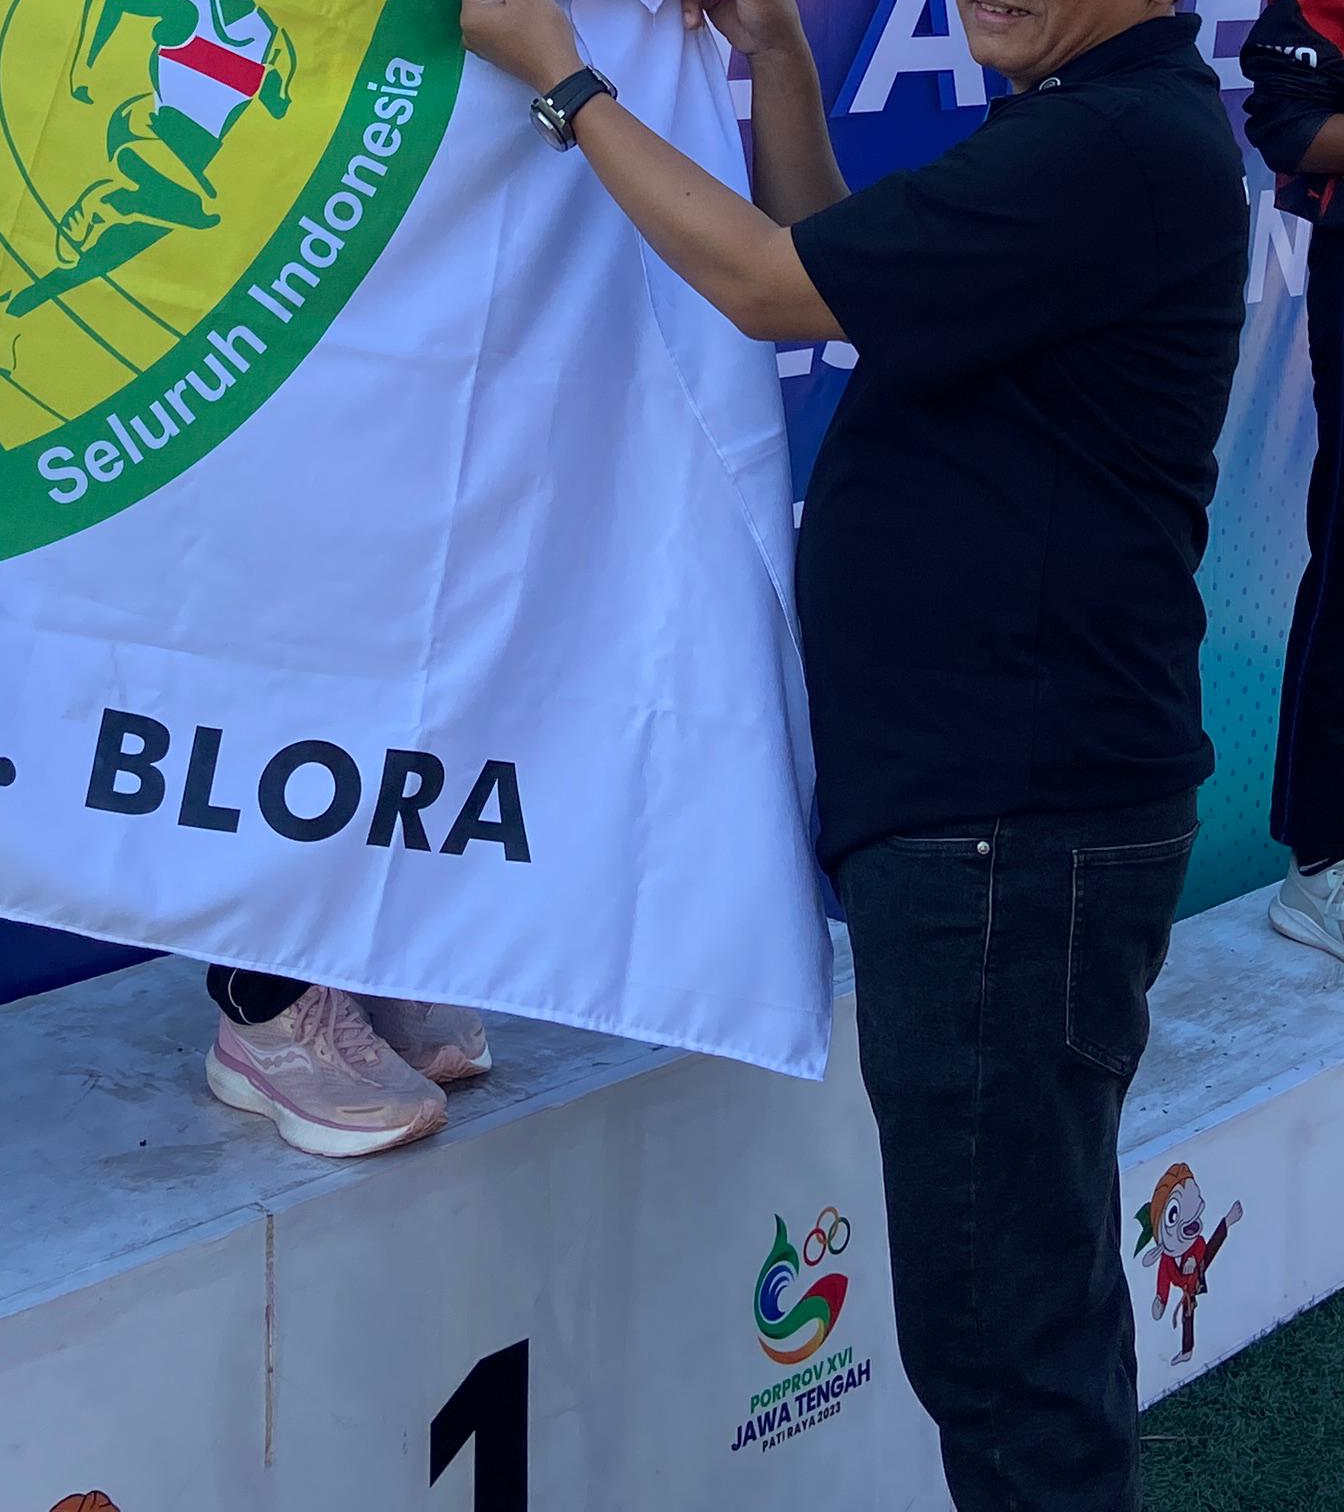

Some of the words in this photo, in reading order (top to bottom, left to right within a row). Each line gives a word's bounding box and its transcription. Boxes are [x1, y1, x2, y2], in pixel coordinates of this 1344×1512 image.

[36, 327, 269, 504] Seluruh
[248, 57, 427, 325] Indonesia
[84, 707, 533, 864] BLORA
[429, 1337, 529, 1511] 1
[731, 1402, 791, 1451] JAWA
[794, 1358, 871, 1418] TENGAH
[750, 1361, 824, 1414] PORPROV
[827, 1346, 853, 1375] XVI
[762, 1432, 786, 1453] PATI
[787, 1415, 816, 1439] RAYA
[817, 1401, 841, 1423] 2023
